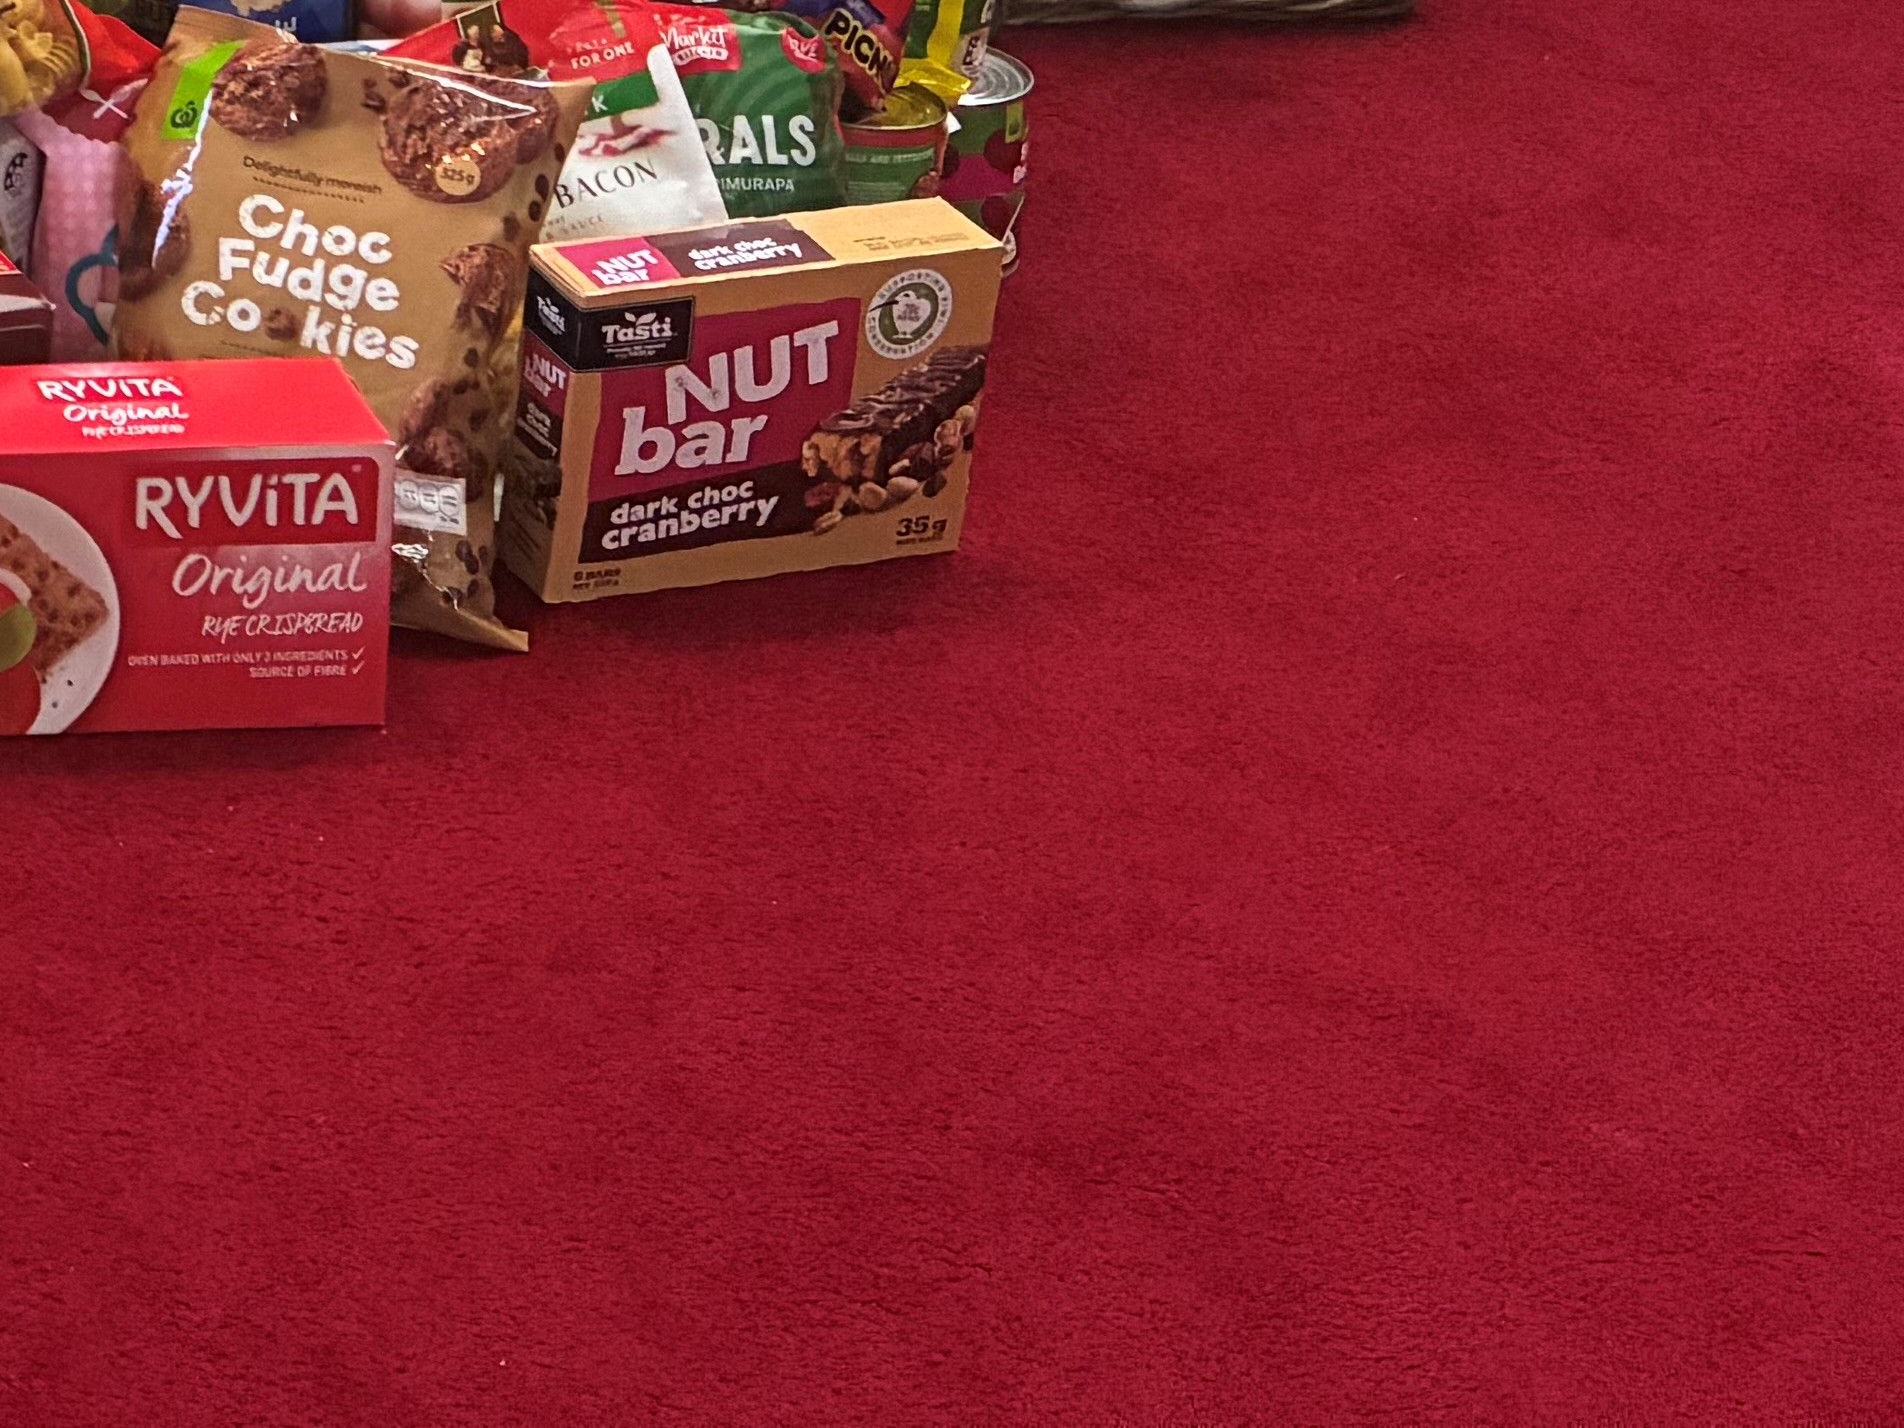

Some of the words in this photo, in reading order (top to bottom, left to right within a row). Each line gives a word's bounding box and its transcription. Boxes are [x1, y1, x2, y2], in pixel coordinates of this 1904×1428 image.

[570, 51, 601, 69] FOR
[602, 42, 635, 62] ONE
[242, 155, 322, 187] Delightfully
[323, 177, 382, 196] moreish
[552, 157, 658, 209] BACON
[238, 193, 392, 266] Choc
[217, 238, 400, 313] Fudge
[593, 267, 650, 286] bar
[599, 251, 658, 275] NUT
[602, 321, 673, 342] Tasti
[40, 377, 185, 404] RYVITA
[666, 321, 839, 425] NUT
[63, 402, 190, 425] Original
[614, 407, 768, 476] bar
[134, 472, 360, 540] RYVITA
[610, 494, 679, 525] dark
[687, 479, 755, 508] choc
[600, 495, 780, 551] cranberry
[895, 517, 928, 539] 35
[172, 550, 368, 609] Original
[202, 618, 240, 643] RYE
[243, 611, 363, 636] CRISPBREAD
[160, 653, 198, 666] BAKED
[200, 652, 230, 665] WITH
[232, 651, 261, 665] ONLY
[272, 650, 348, 664] INGREDIENTS
[249, 665, 291, 679] SOURCE
[294, 665, 310, 678] OF
[312, 664, 347, 678] FIBRE
